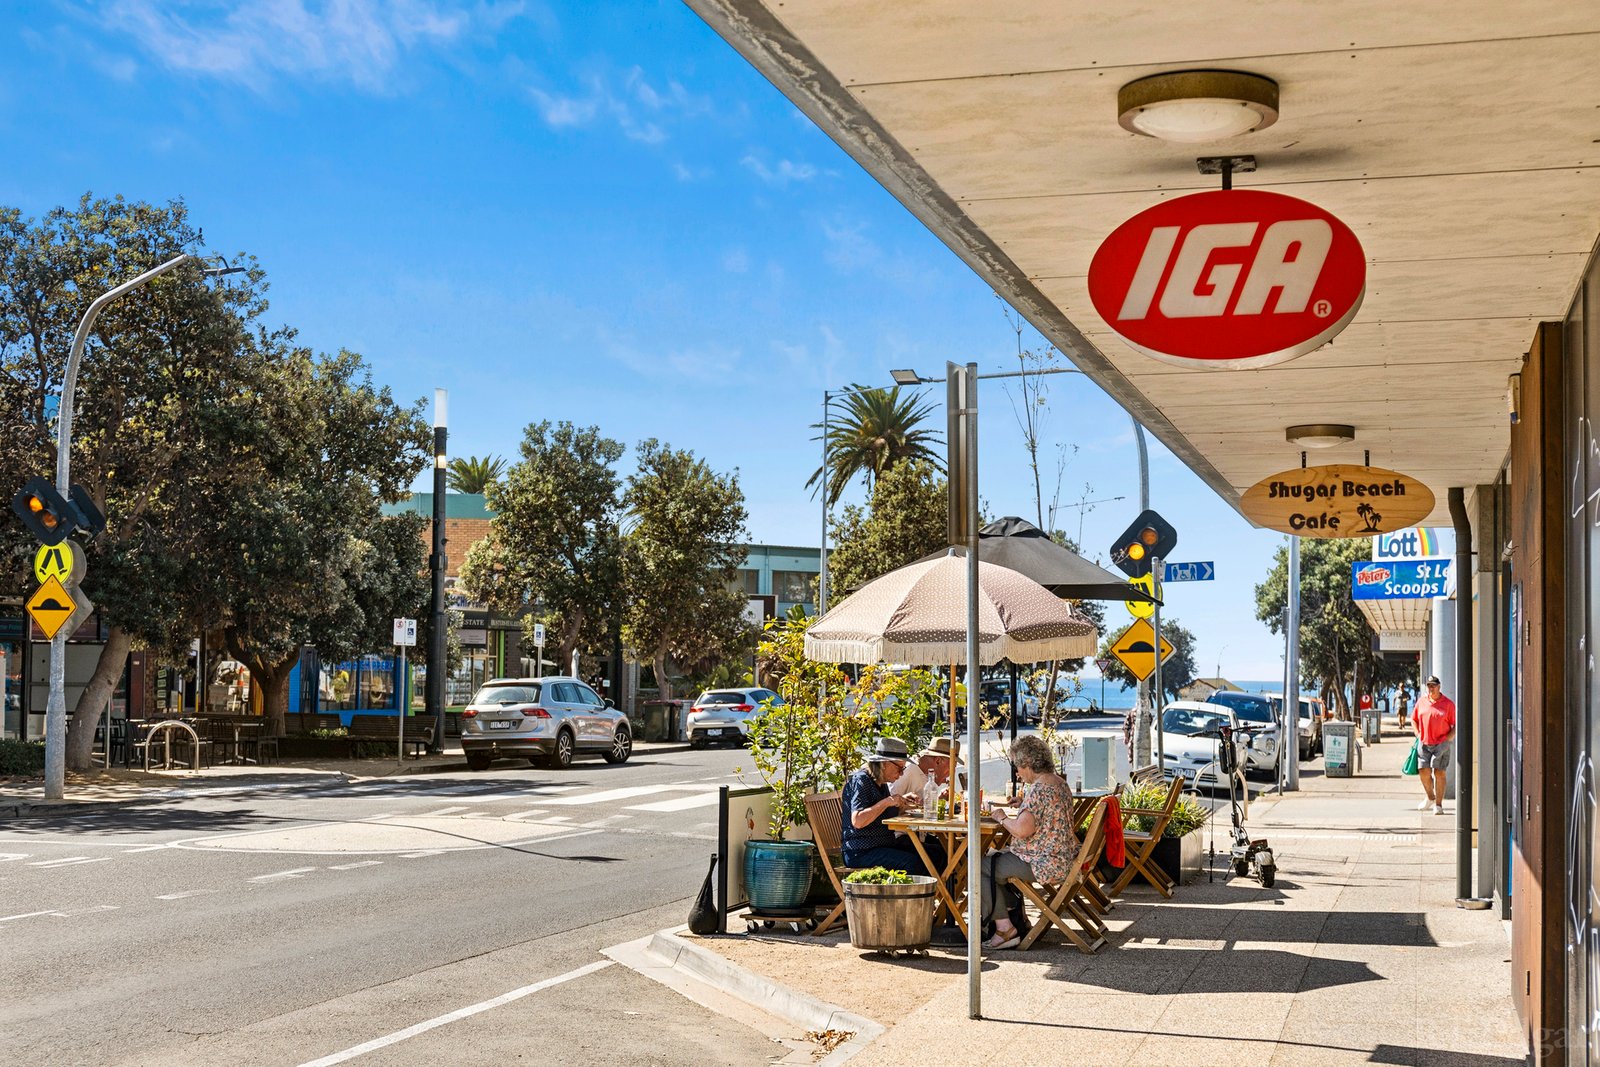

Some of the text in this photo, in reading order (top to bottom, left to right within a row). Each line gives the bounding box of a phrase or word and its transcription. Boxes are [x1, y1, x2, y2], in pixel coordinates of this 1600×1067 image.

[1117, 218, 1333, 321] IGA
[1269, 480, 1406, 502] Shugar Beach
[1378, 532, 1417, 557] Lott
[1356, 568, 1391, 585] Peters
[1416, 565, 1431, 579] St
[1384, 581, 1438, 597] Scoops
